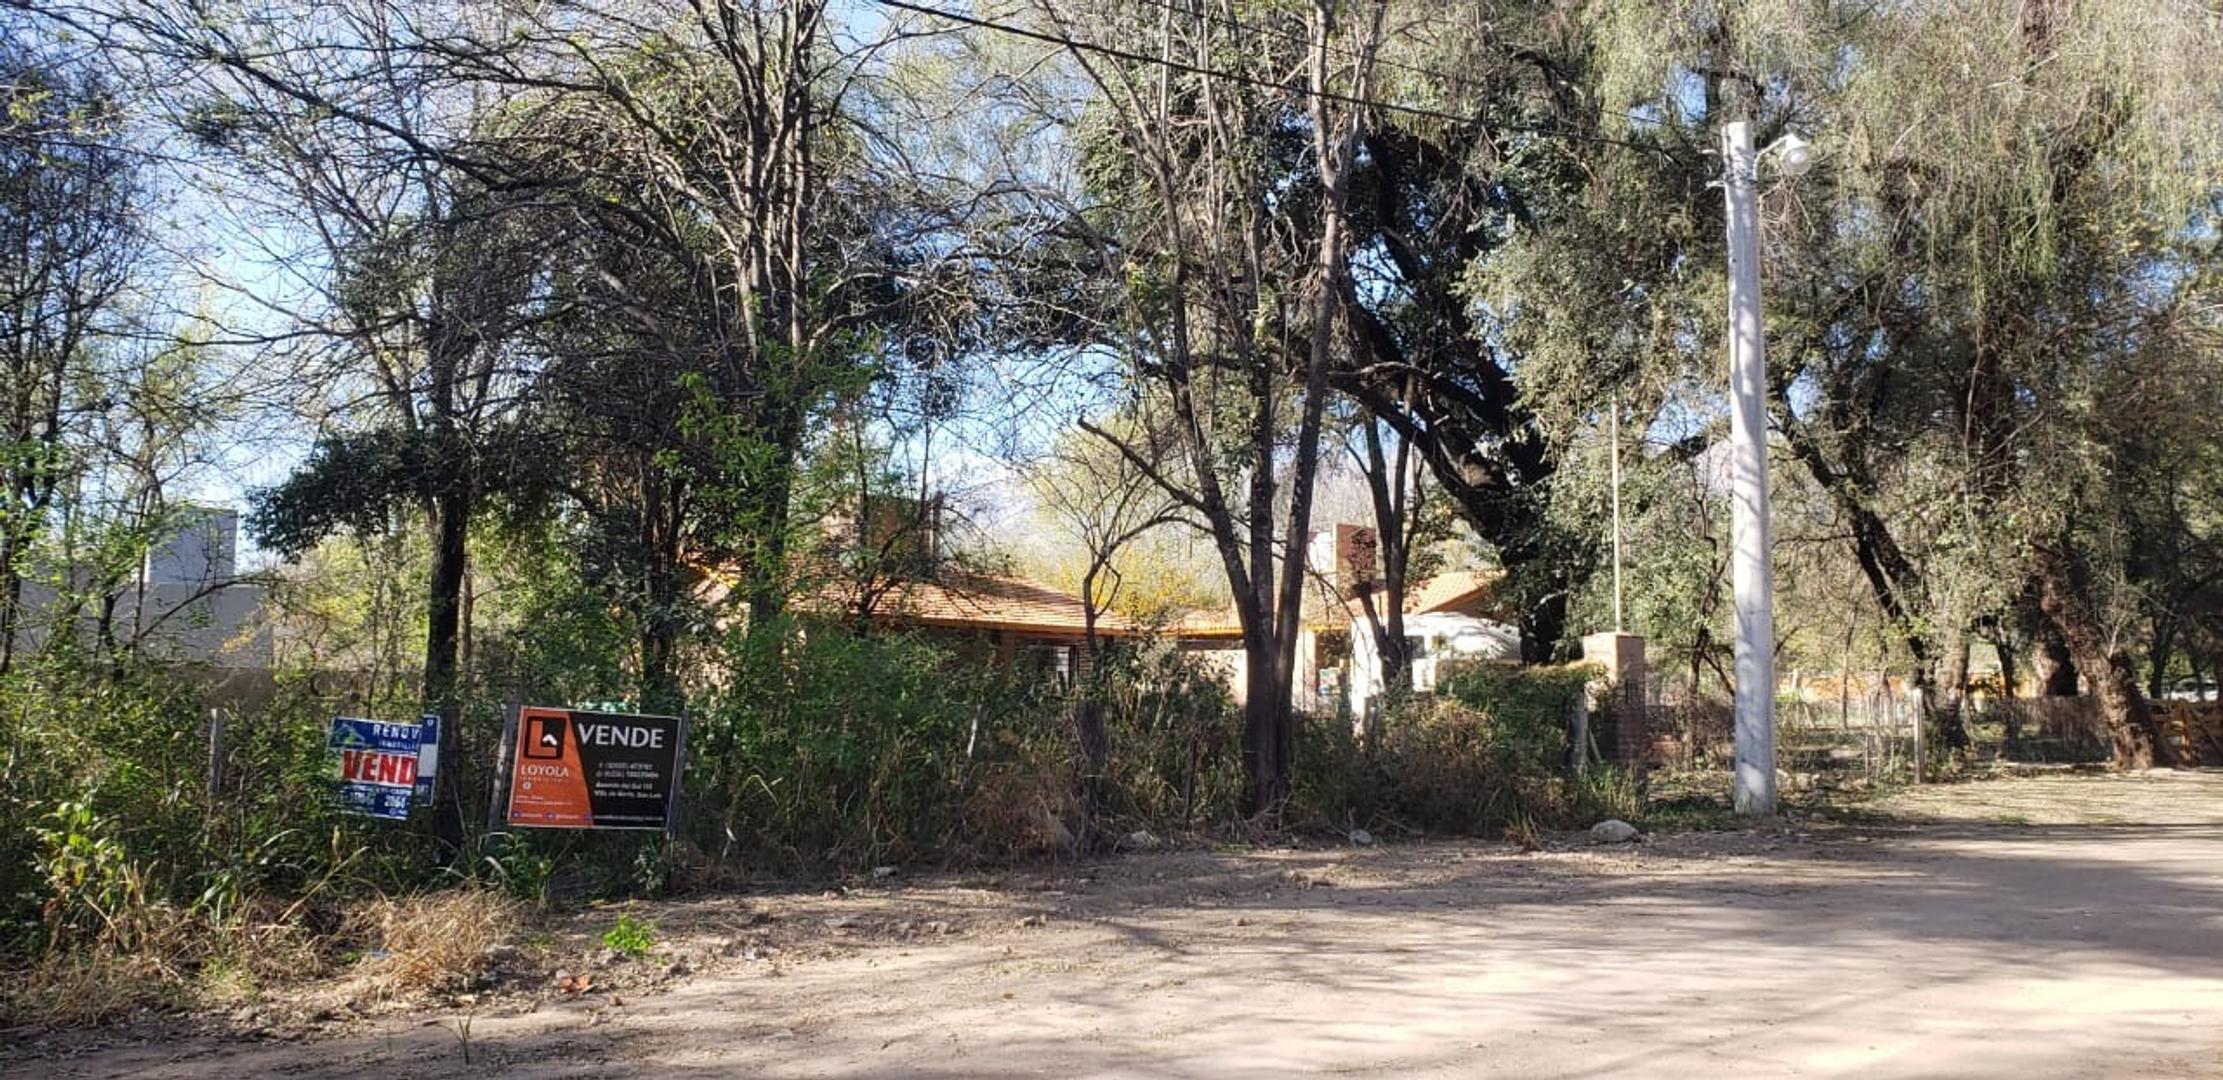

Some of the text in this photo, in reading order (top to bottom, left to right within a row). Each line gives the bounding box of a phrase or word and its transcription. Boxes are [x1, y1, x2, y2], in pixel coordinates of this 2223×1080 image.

[577, 723, 665, 748] VENDE
[343, 750, 417, 785] VEND
[520, 763, 570, 777] LOYOLA
